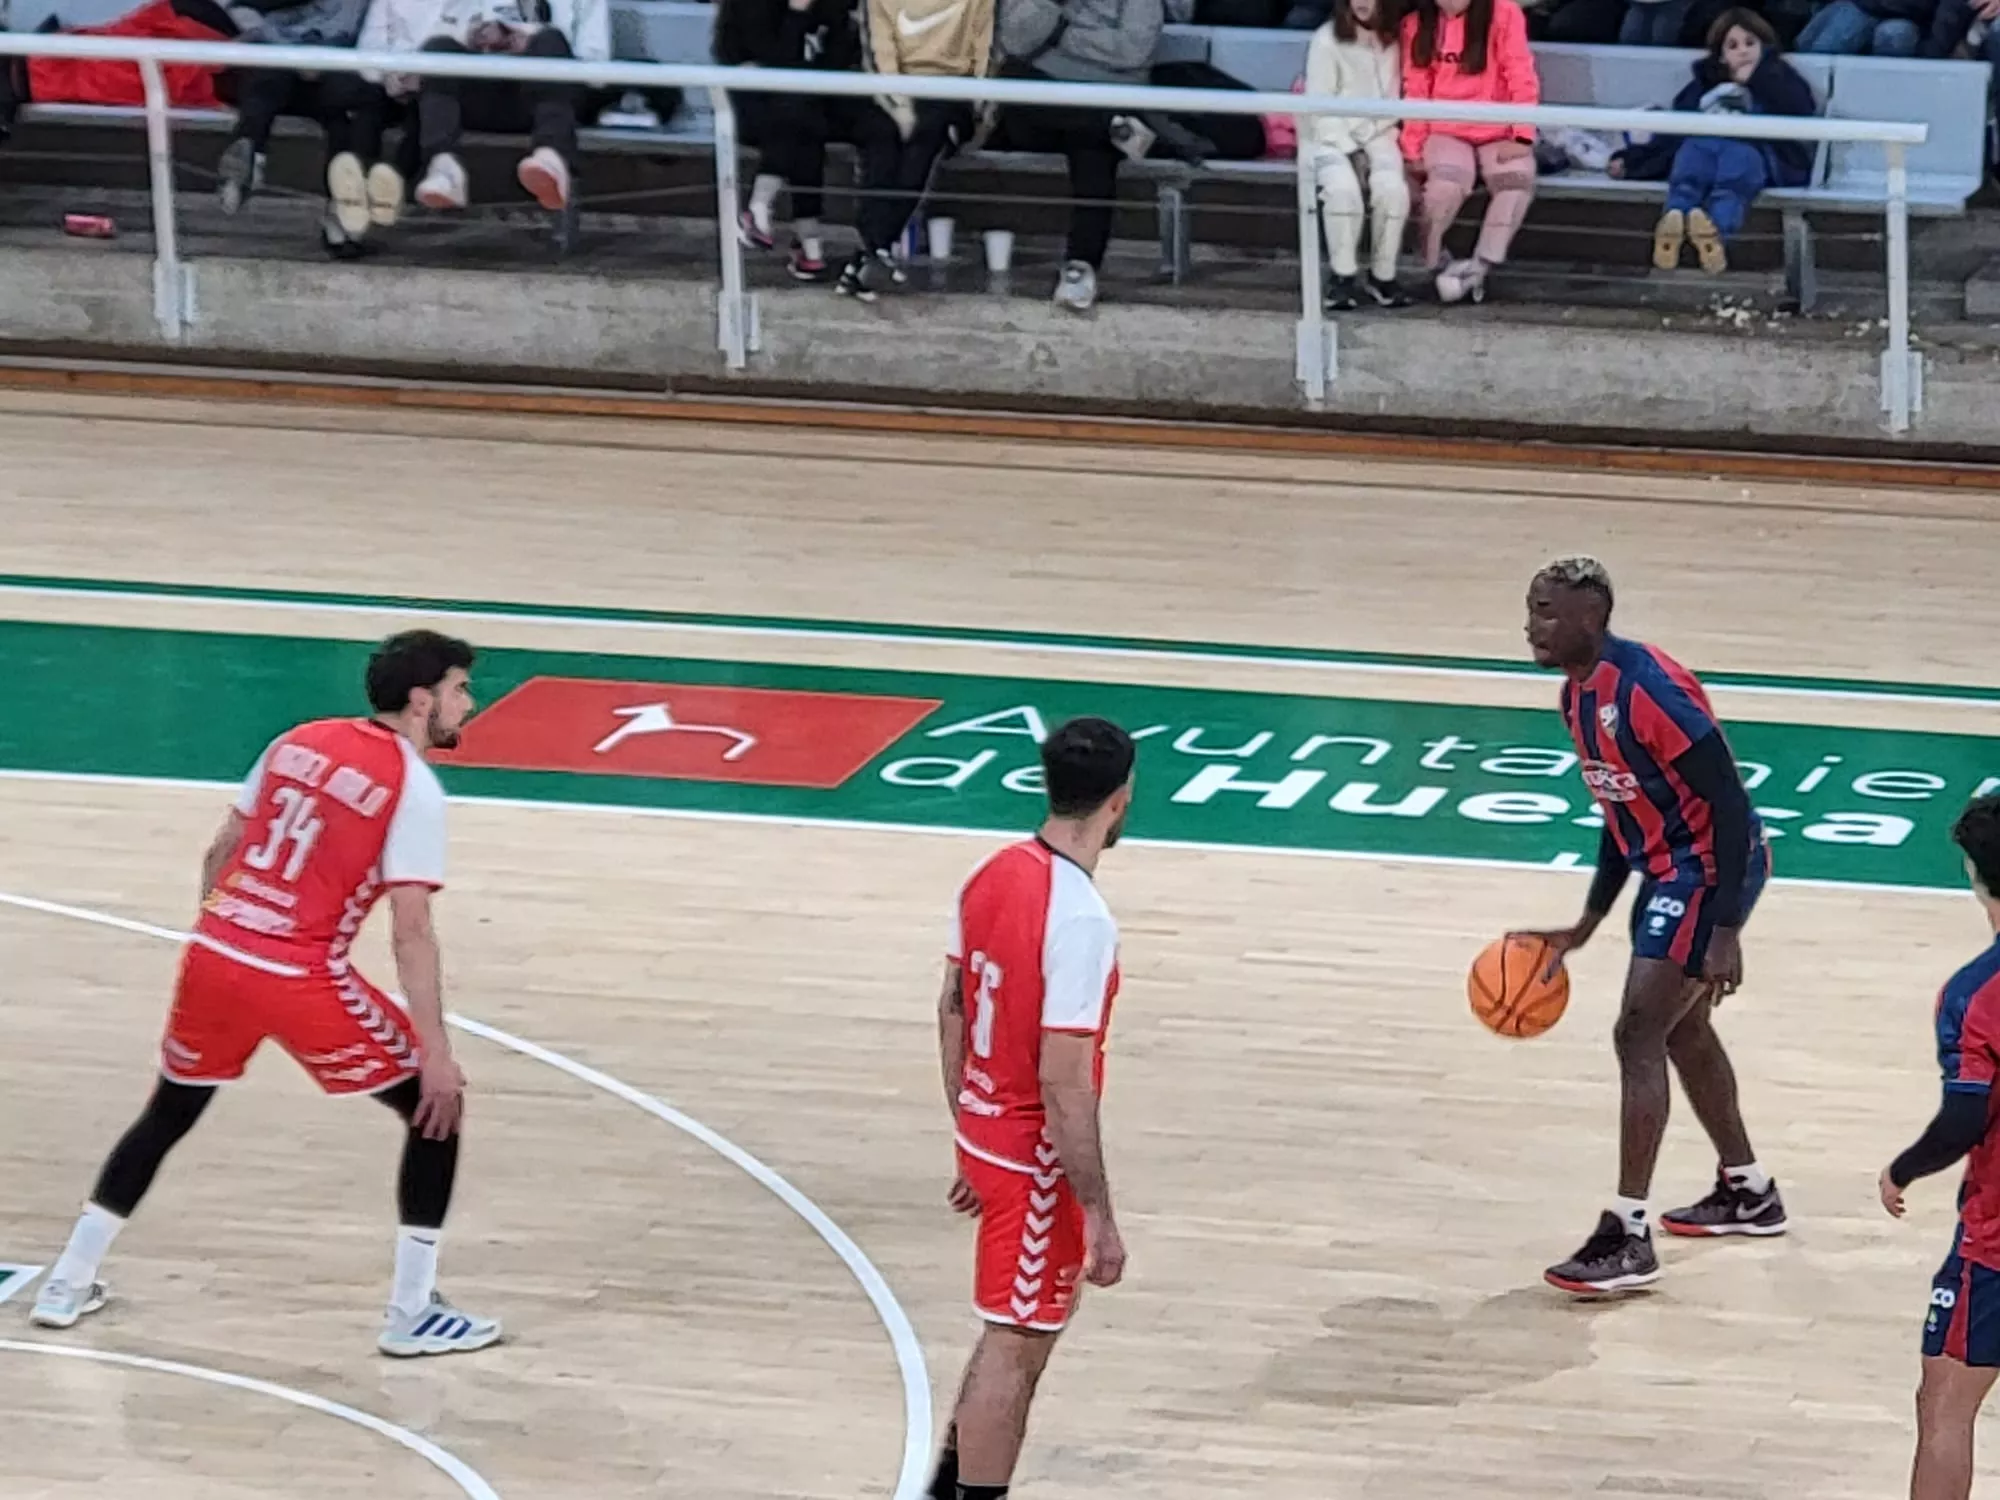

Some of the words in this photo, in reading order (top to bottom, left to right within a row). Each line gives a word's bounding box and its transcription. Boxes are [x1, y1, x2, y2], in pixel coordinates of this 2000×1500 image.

[926, 704, 2000, 799] Auntaie
[244, 786, 325, 882] 34
[1171, 764, 1915, 846] Huea
